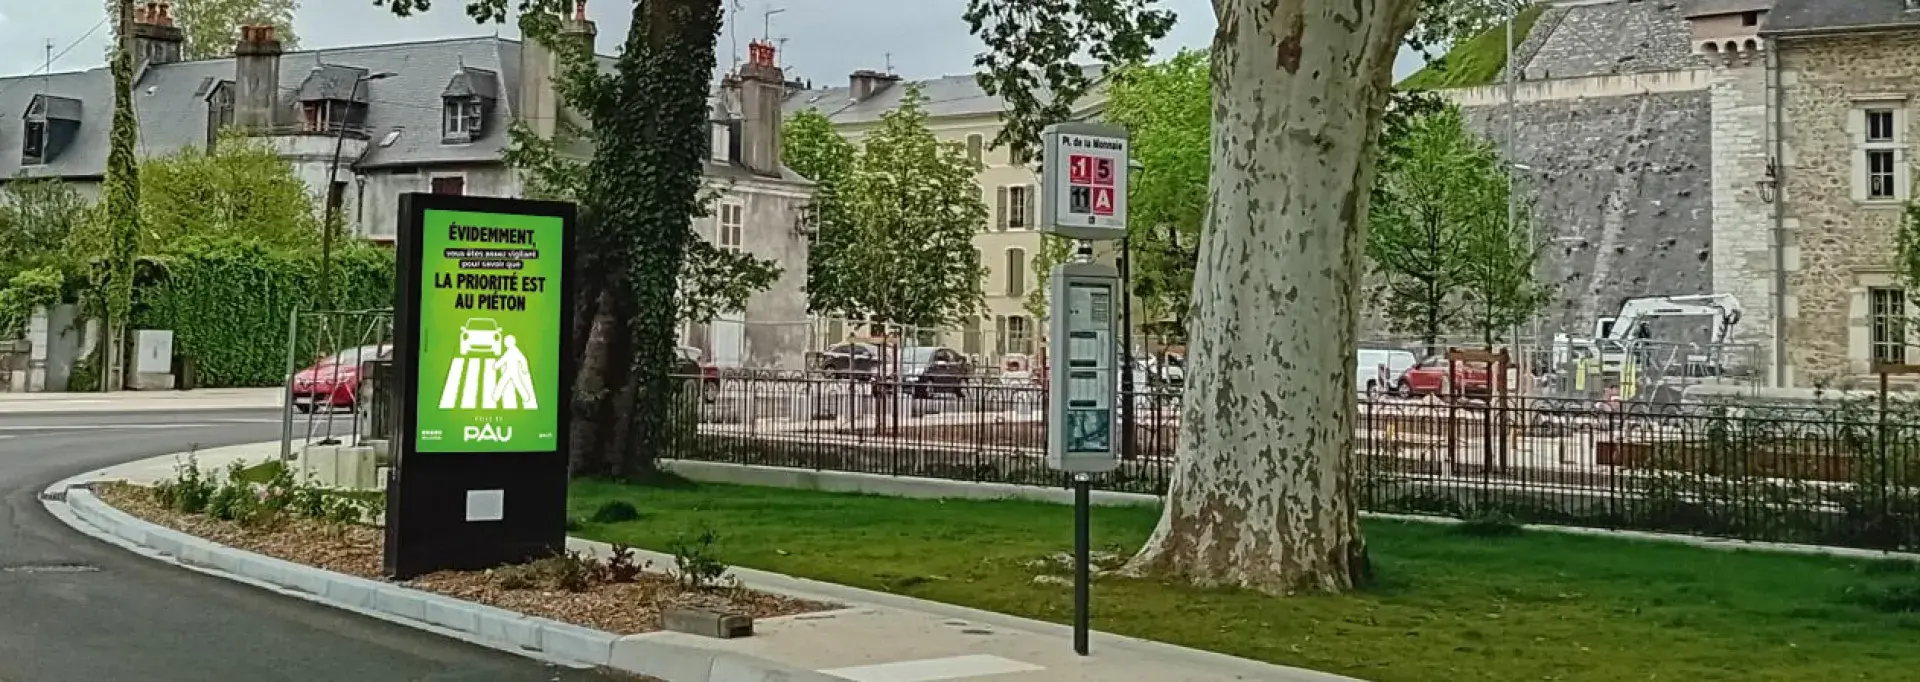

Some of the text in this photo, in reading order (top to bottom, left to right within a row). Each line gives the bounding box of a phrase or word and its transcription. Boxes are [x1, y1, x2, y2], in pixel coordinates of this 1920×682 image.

[1073, 136, 1082, 147] de
[1084, 137, 1091, 148] la
[1097, 160, 1110, 179] 5
[1071, 187, 1089, 208] 11
[1095, 189, 1111, 208] A
[448, 221, 536, 249] ÉVIDEMMENT,
[446, 250, 465, 258] vous
[466, 249, 484, 258] êtes
[507, 250, 537, 260] vigilant
[461, 261, 480, 269] pour
[482, 260, 505, 268] savoir
[434, 272, 546, 293] LA PRIORITÉ EST
[455, 290, 526, 312] AU PIÉTON
[463, 422, 513, 442] PAU
